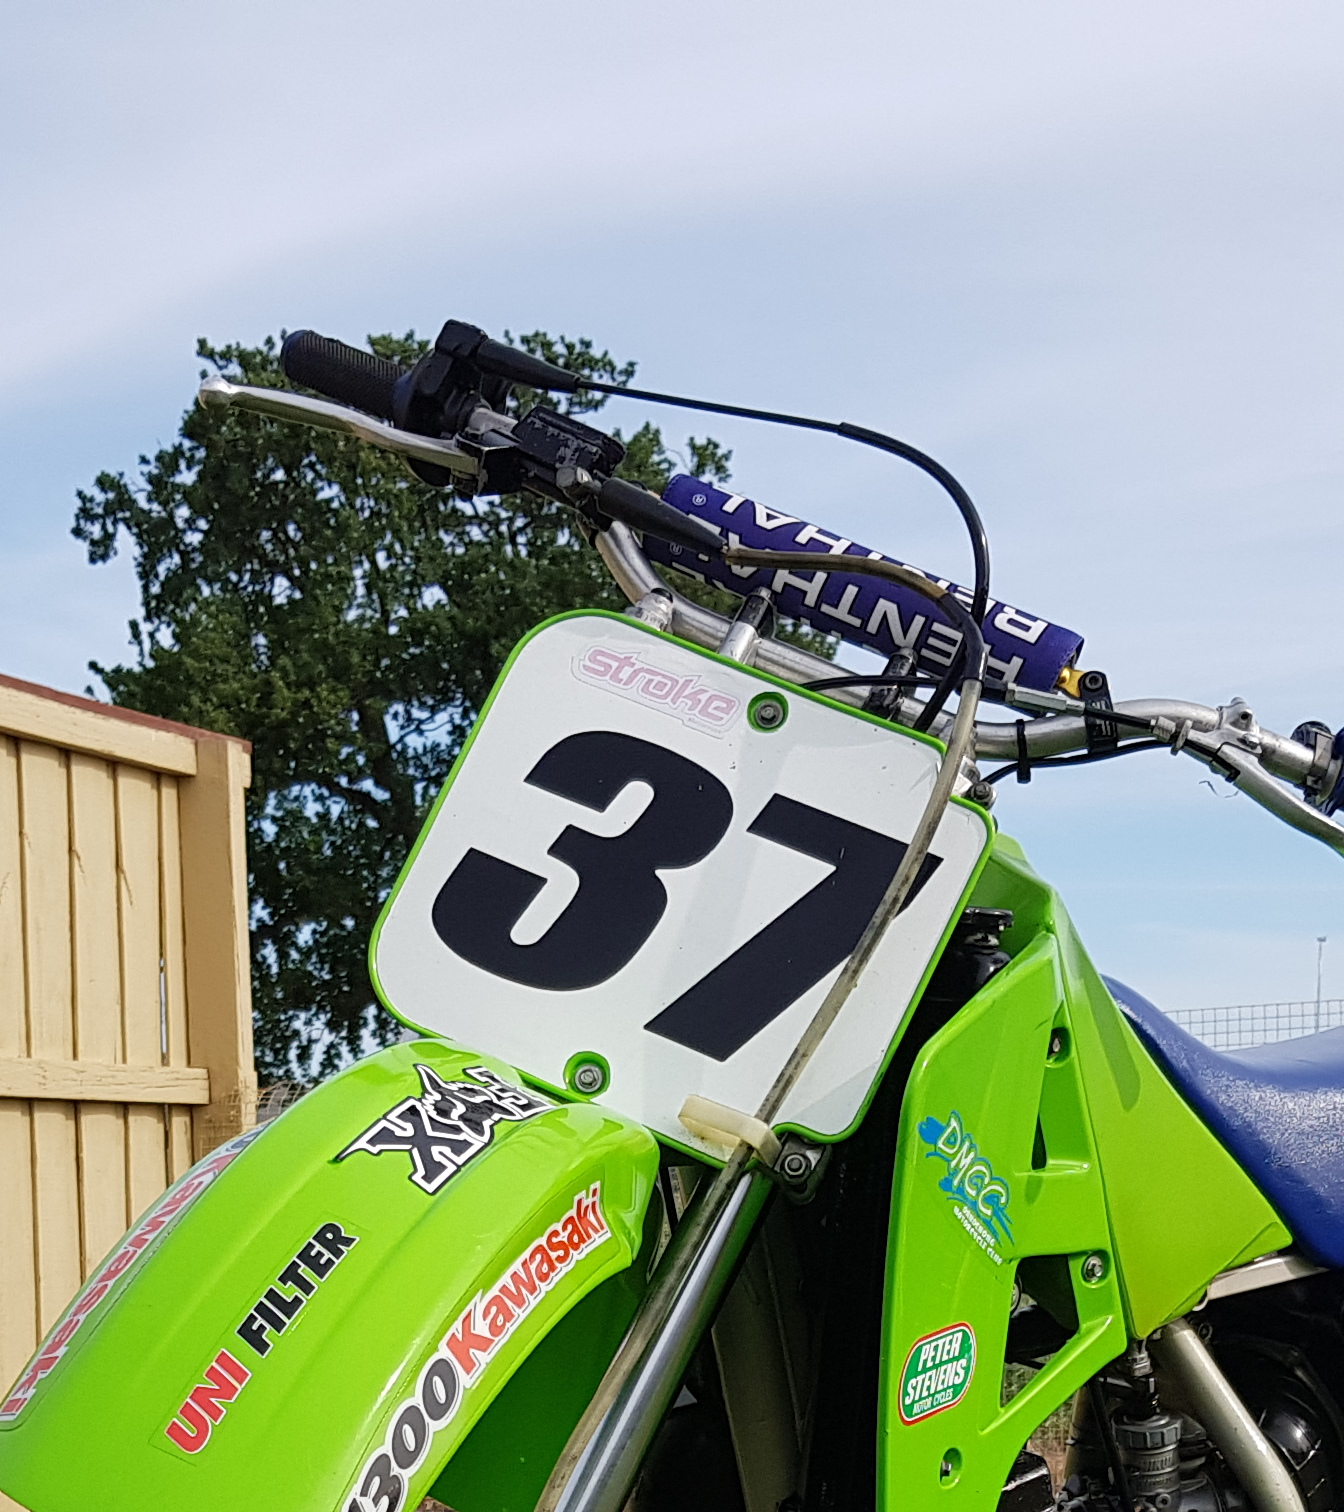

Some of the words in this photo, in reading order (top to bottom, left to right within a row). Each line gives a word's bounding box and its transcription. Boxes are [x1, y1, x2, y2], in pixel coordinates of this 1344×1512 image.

[582, 649, 736, 722] stroke
[431, 730, 944, 1063] 37
[936, 1117, 1006, 1218] DMCC
[165, 1350, 251, 1455] UNI
[235, 1221, 358, 1358] FILTER
[917, 1331, 963, 1371] PETER
[904, 1358, 967, 1405] STEVENS
[932, 1388, 954, 1406] CYCLES
